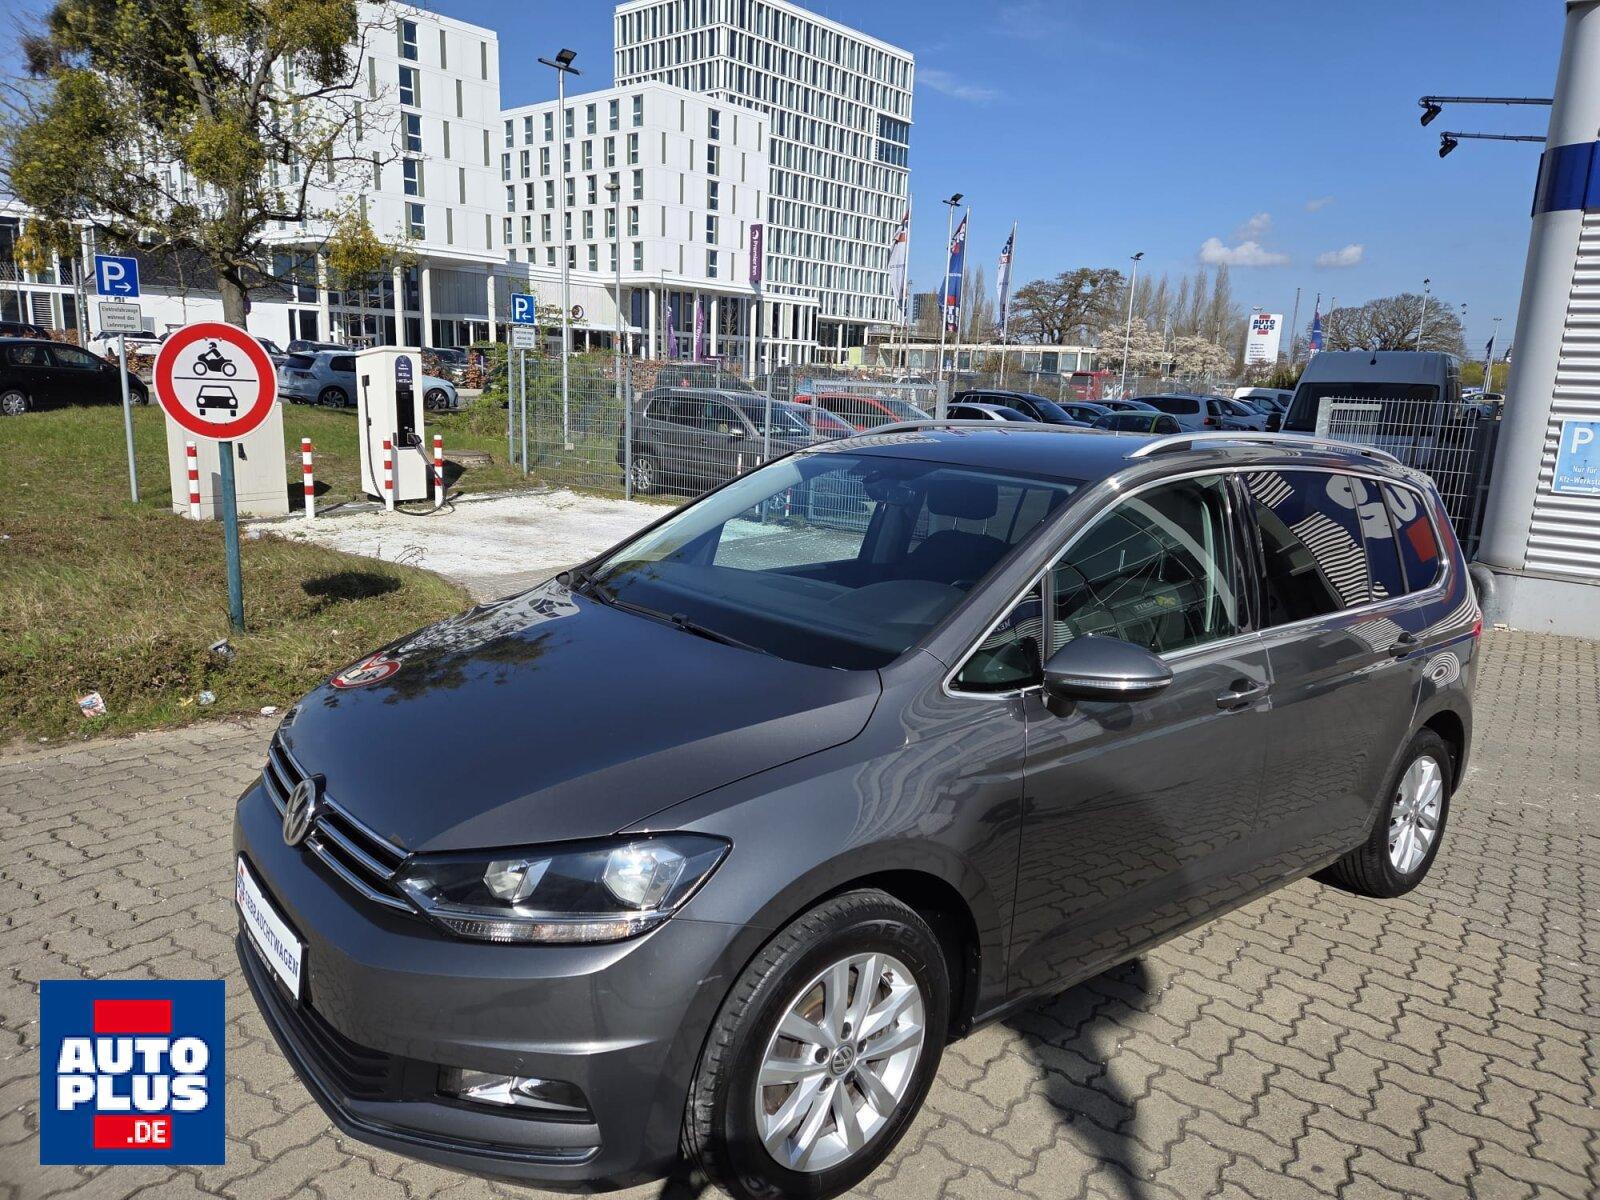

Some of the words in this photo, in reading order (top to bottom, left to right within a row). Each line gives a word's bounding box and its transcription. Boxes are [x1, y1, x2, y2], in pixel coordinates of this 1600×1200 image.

[101, 260, 125, 291] P
[515, 297, 529, 320] P
[1571, 427, 1594, 454] P
[1572, 464, 1585, 473] Nur
[1587, 465, 1598, 475] für
[244, 889, 300, 979] GEBRAUCHTWAGEN
